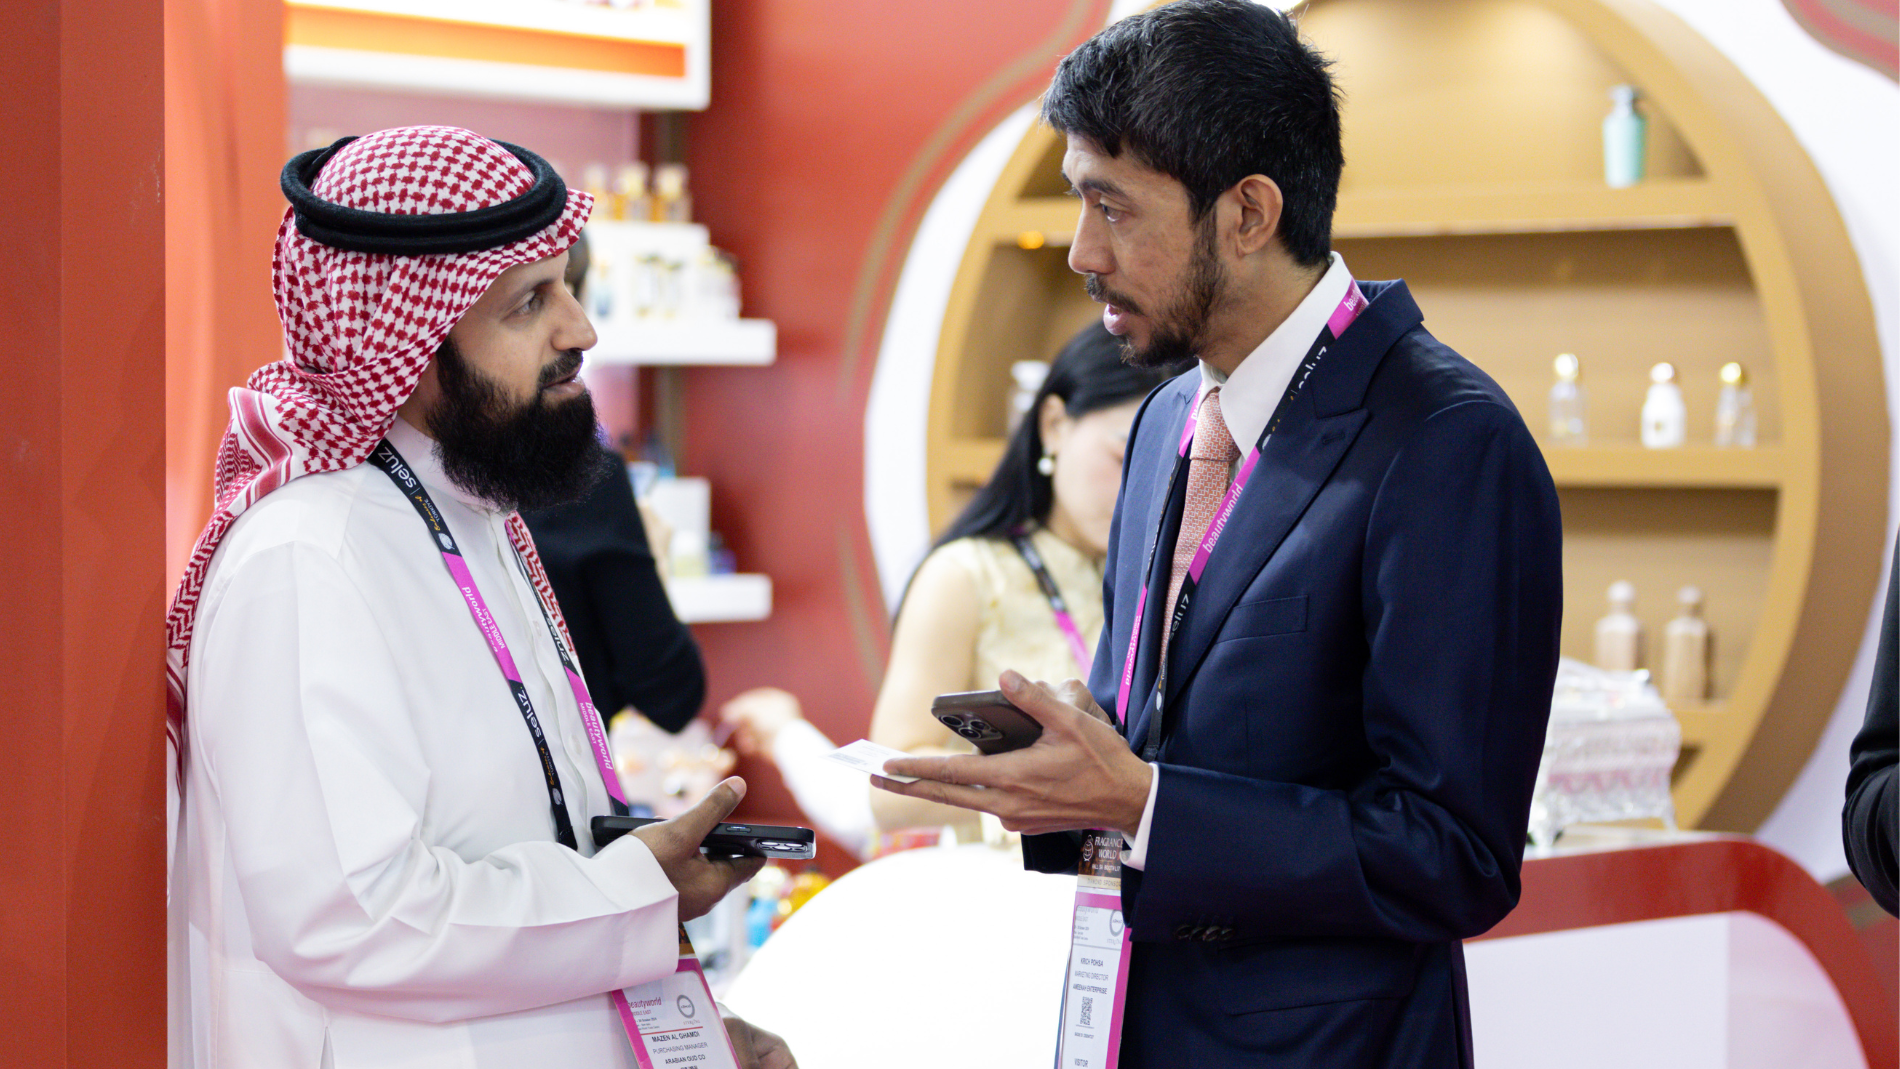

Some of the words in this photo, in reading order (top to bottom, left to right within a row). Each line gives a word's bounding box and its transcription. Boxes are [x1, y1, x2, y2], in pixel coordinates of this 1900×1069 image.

[378, 446, 417, 488] seluz
[482, 608, 493, 625] EAST
[489, 625, 506, 649] MIDDLE
[518, 689, 543, 738] seluz
[579, 702, 591, 728] MIDDLE
[589, 728, 597, 744] EAST
[585, 702, 613, 770] beautyworld
[1094, 836, 1124, 848] FRAGRANCE
[1098, 849, 1117, 860] WORLD
[651, 1034, 671, 1042] MAZEN
[652, 1045, 684, 1054] PURCHASING
[684, 1042, 708, 1050] MANAGER
[665, 1056, 687, 1065] ARABIAN
[1074, 1058, 1089, 1068] VISITOR
